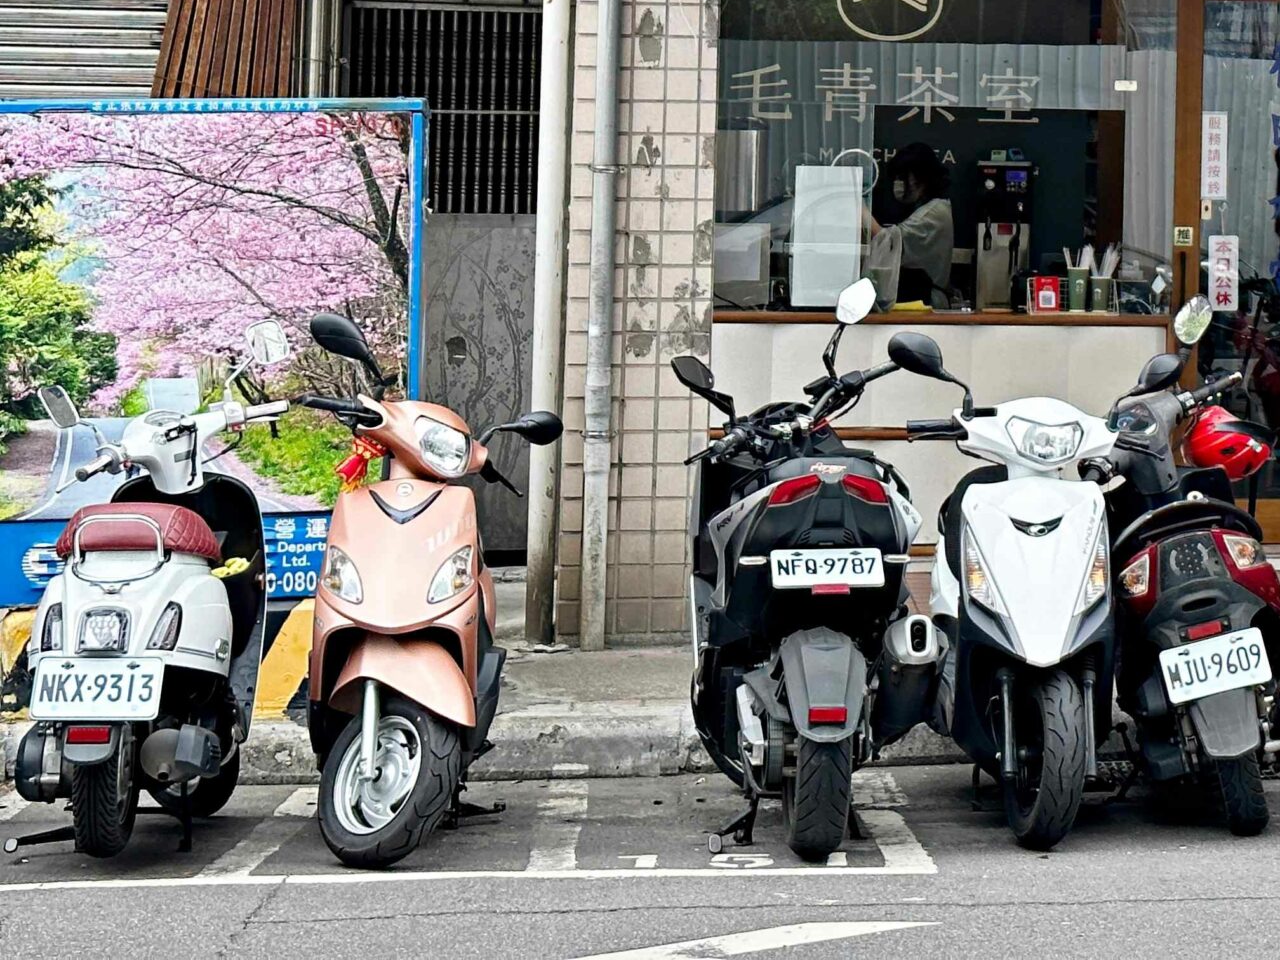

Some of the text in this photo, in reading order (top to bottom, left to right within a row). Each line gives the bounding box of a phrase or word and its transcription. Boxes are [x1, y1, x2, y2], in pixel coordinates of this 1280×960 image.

[729, 62, 1041, 123] 毛青茶室
[1177, 228, 1191, 240] 推
[1215, 240, 1233, 306] 本日公休
[282, 555, 311, 568] Ltd.
